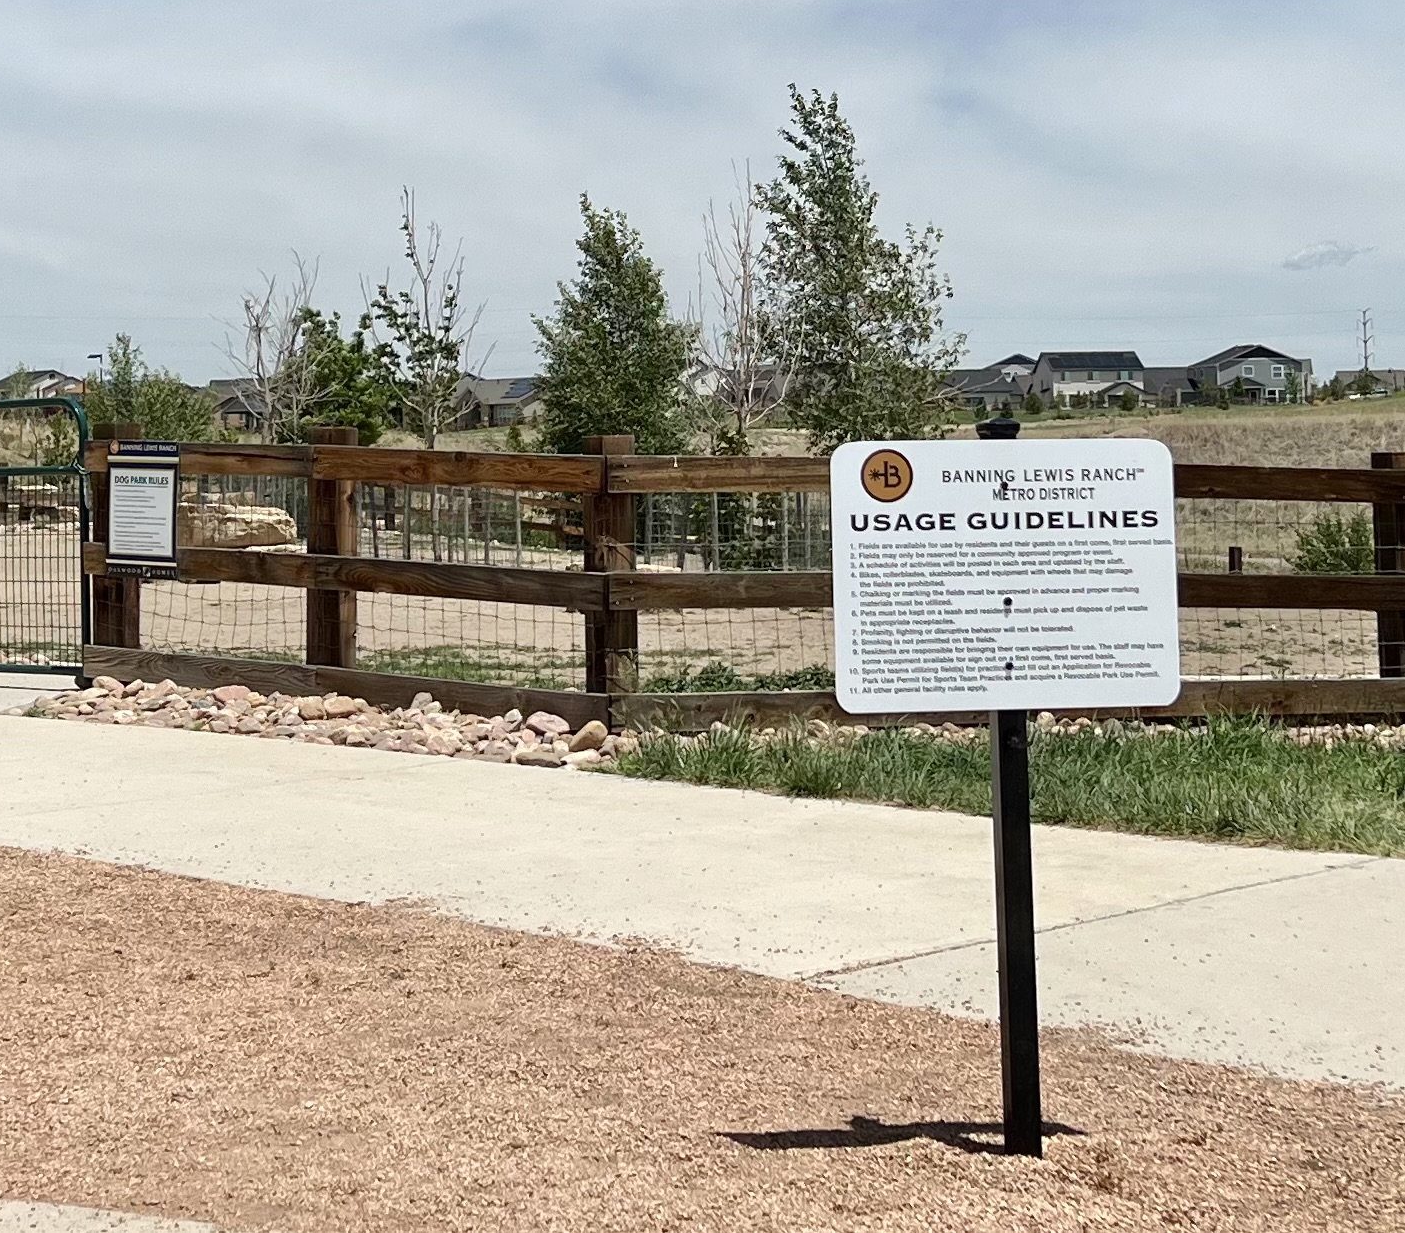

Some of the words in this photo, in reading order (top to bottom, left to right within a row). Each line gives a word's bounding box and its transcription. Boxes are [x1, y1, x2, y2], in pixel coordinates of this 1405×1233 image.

[114, 475, 129, 484] DOG
[130, 476, 148, 484] PARK
[148, 477, 169, 485] RULES
[942, 469, 1016, 483] BANNING
[1024, 469, 1074, 482] LEWIS
[992, 488, 1036, 500] METRO
[1039, 487, 1095, 500] DISTRICT
[850, 513, 956, 533] USAGE
[966, 510, 1159, 530] GUIDELINES
